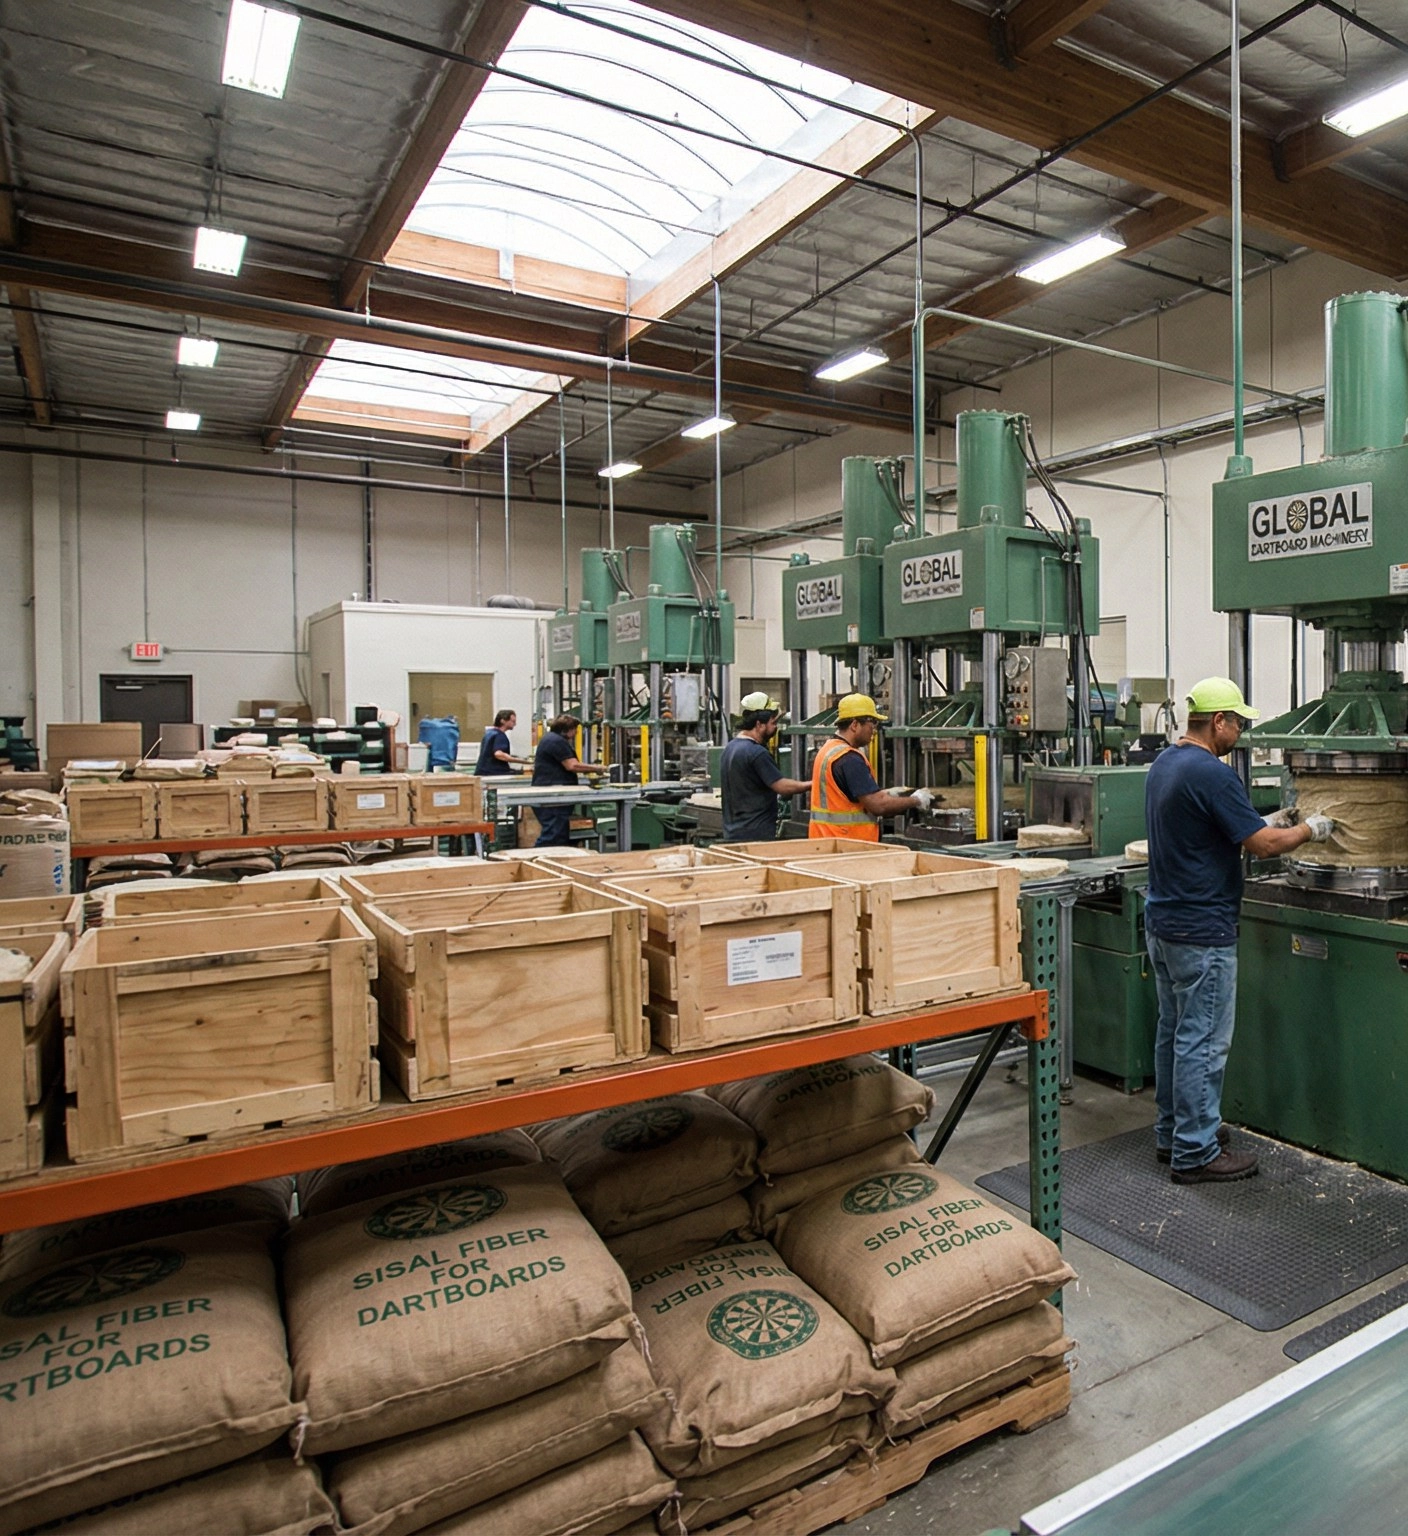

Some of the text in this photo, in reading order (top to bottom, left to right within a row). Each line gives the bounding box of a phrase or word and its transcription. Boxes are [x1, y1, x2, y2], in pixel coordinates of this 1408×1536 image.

[1252, 491, 1369, 538] GLOBAL
[902, 555, 961, 588] GLOBAL
[864, 1199, 986, 1251] SISAL FIBER
[918, 1219, 961, 1242] FOR
[352, 1228, 550, 1290] SISAL FIBER
[884, 1219, 1014, 1278] DARTBOARDS
[430, 1258, 491, 1285] FOR
[695, 1258, 739, 1277] FOR
[357, 1256, 567, 1327] DARTBOARDS
[651, 1276, 725, 1315] FIBER
[95, 1297, 213, 1332] FIBER
[43, 1331, 122, 1366] FOR
